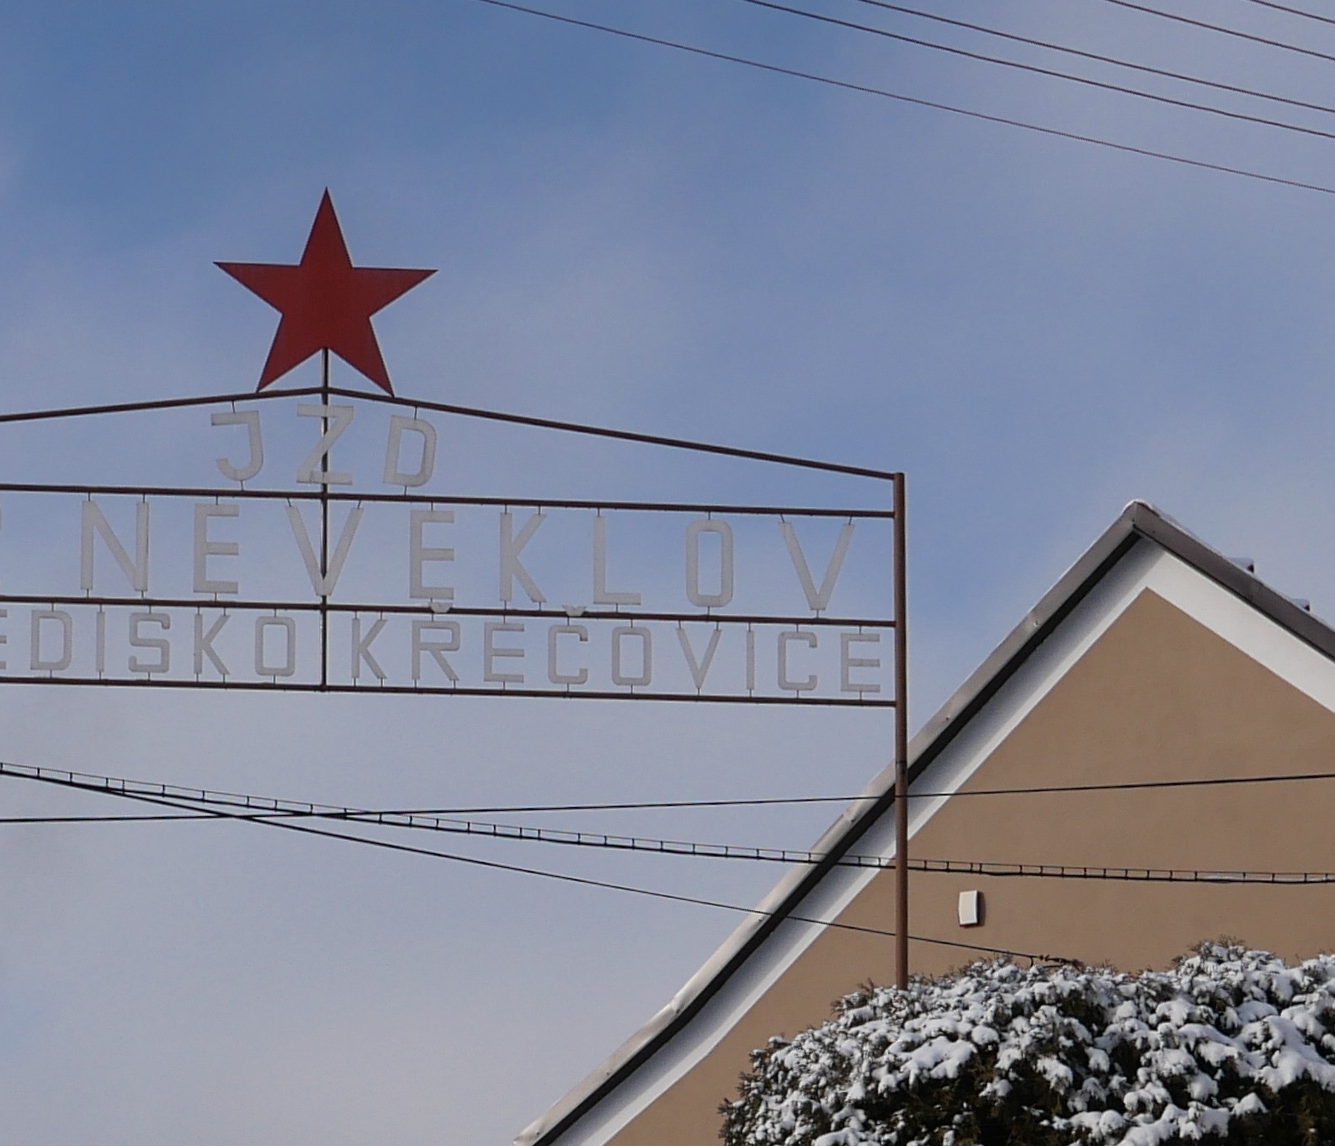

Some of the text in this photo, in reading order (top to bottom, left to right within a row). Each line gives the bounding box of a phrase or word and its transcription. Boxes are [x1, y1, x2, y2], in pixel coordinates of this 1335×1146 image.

[211, 404, 438, 487] JZD
[80, 500, 855, 611] NEVEKLOV
[351, 602, 882, 693] KŘEČOVICE
